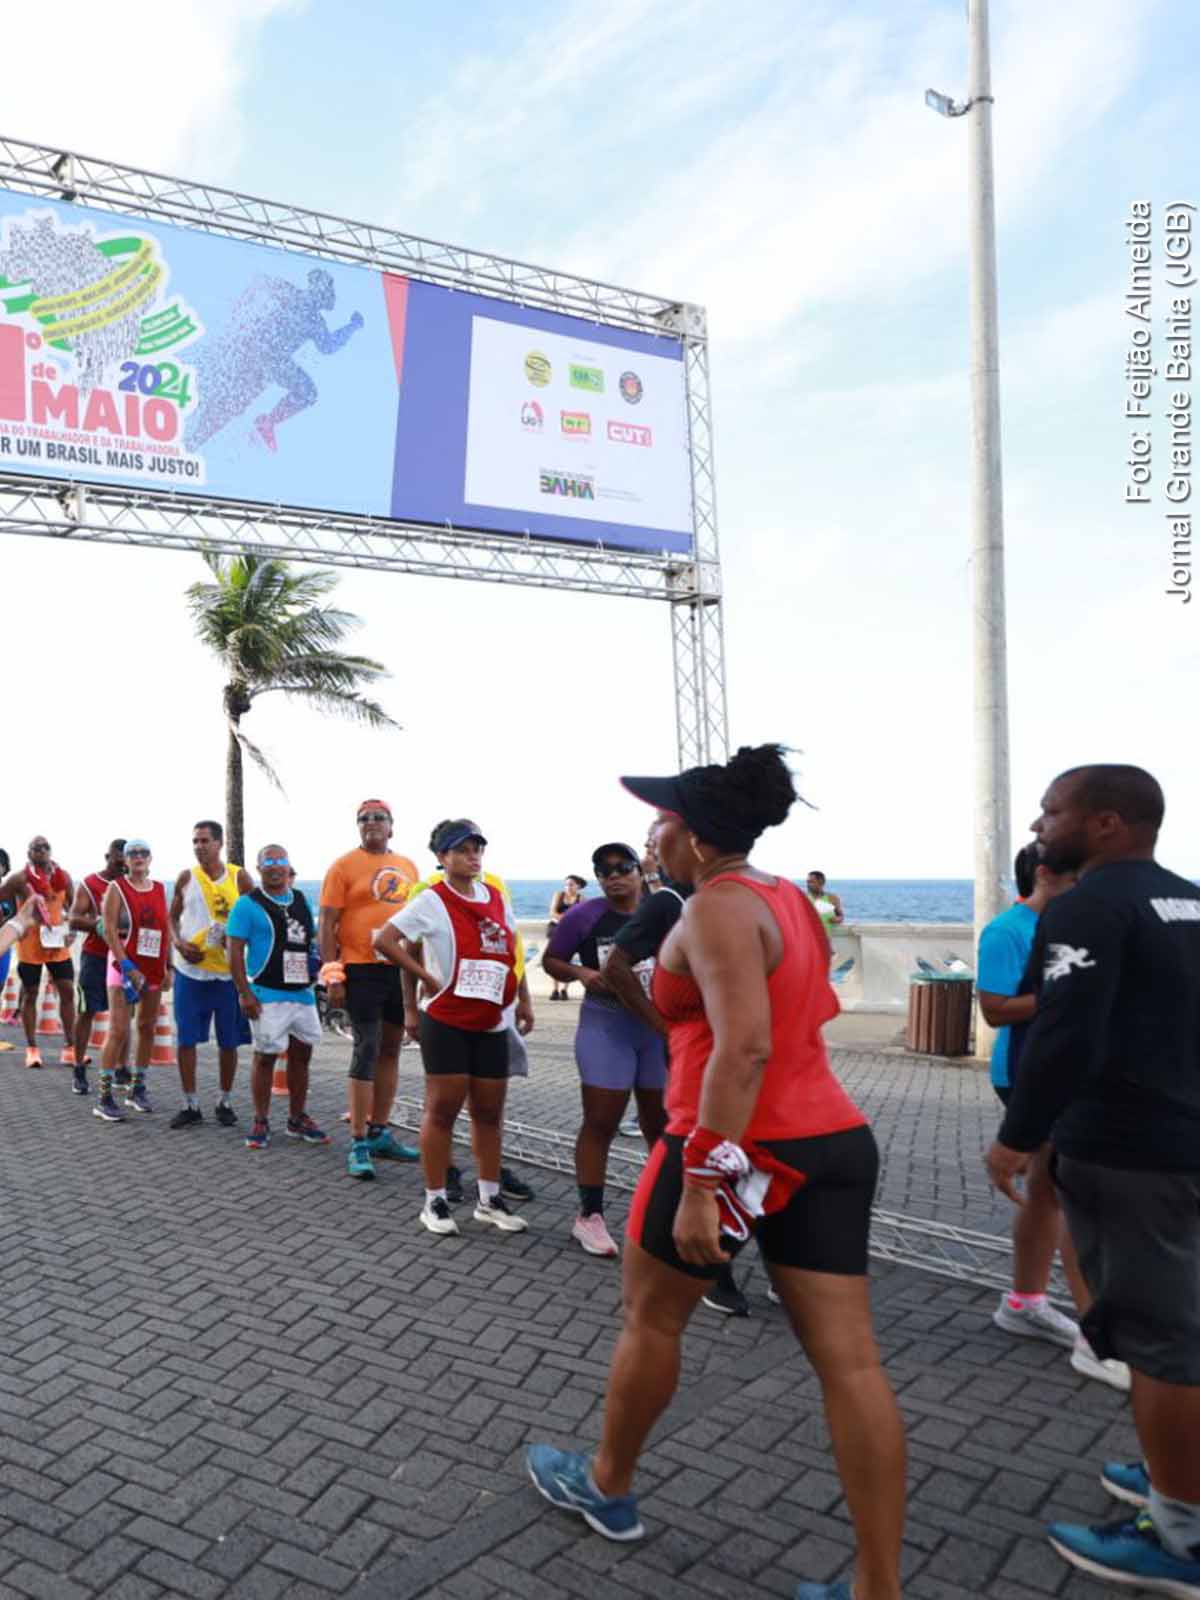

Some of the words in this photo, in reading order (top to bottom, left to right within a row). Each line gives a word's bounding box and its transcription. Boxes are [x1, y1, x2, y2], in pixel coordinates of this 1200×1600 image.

[31, 361, 57, 381] de
[118, 360, 192, 408] 2024
[31, 380, 179, 442] MAIO
[16, 438, 41, 457] UM
[46, 442, 102, 465] BRASIL
[106, 449, 144, 470] MAIS
[147, 455, 199, 478] JUSTO!
